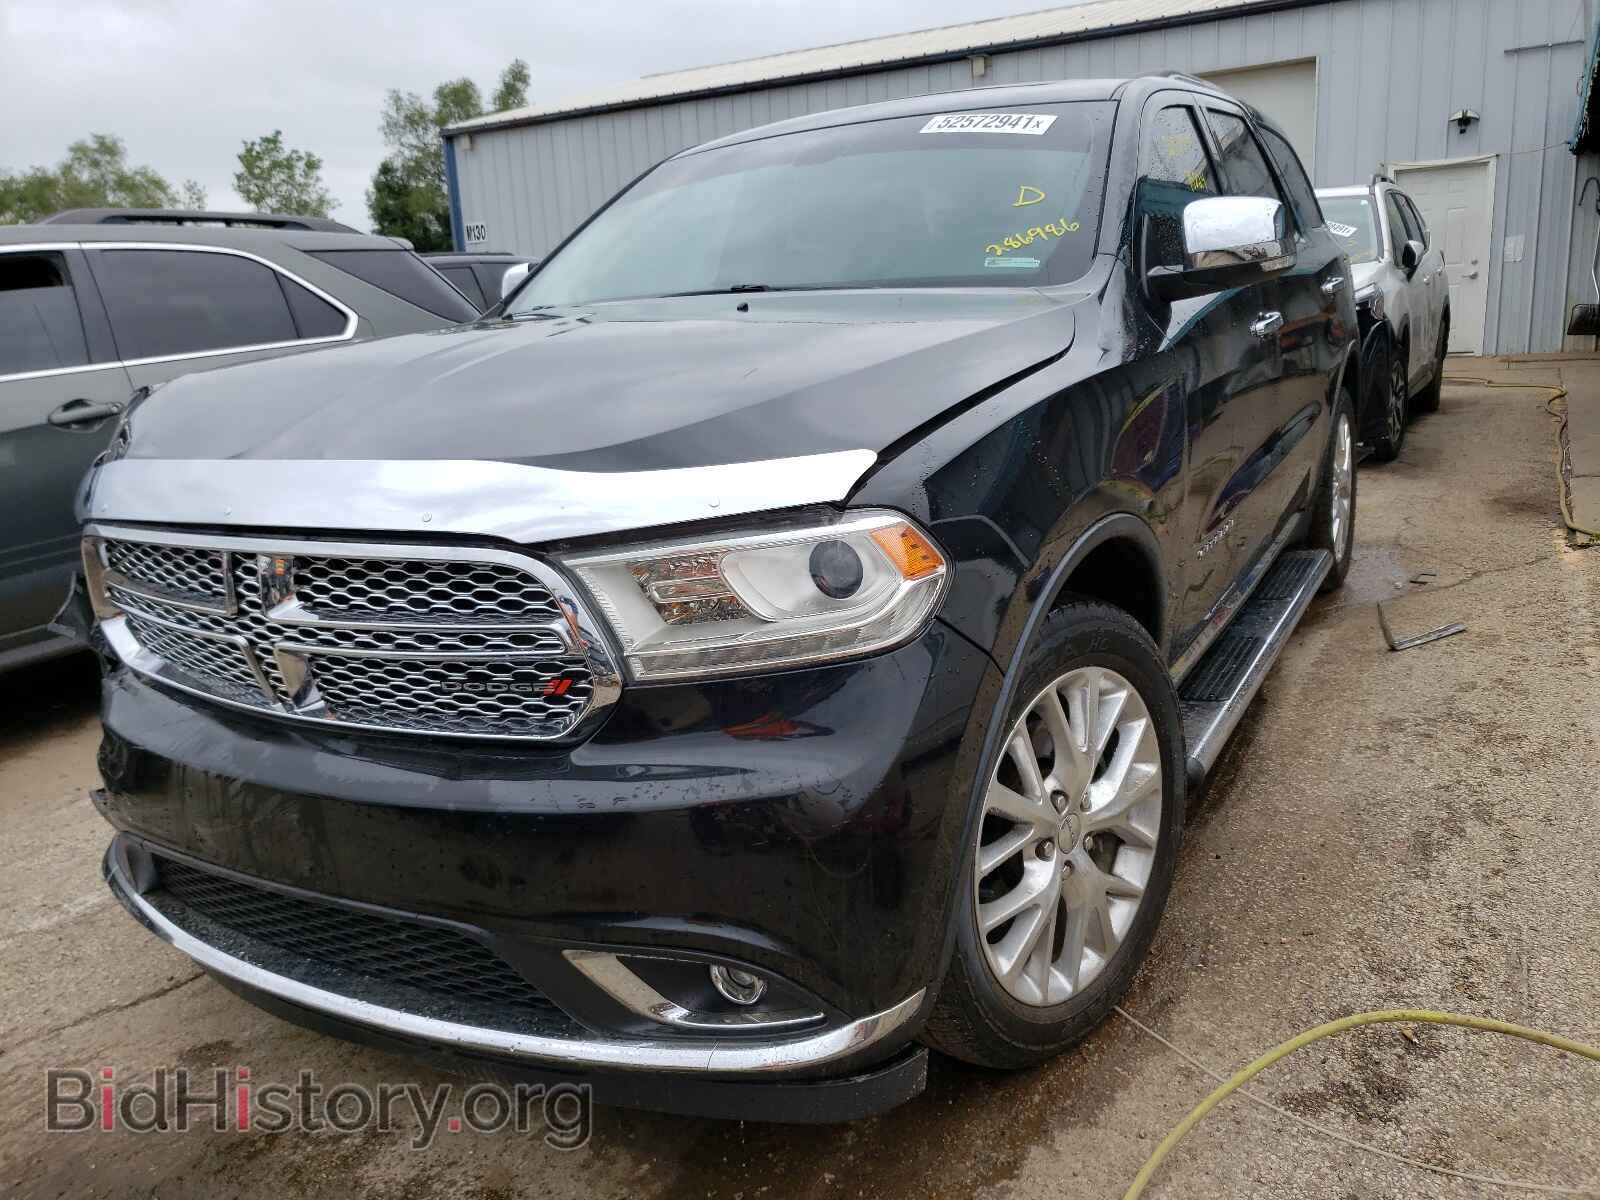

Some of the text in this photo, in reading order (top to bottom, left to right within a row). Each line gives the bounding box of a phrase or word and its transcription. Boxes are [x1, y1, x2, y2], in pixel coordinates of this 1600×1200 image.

[1012, 186, 1046, 207] D
[466, 224, 486, 241] M130
[440, 681, 556, 693] DODGE
